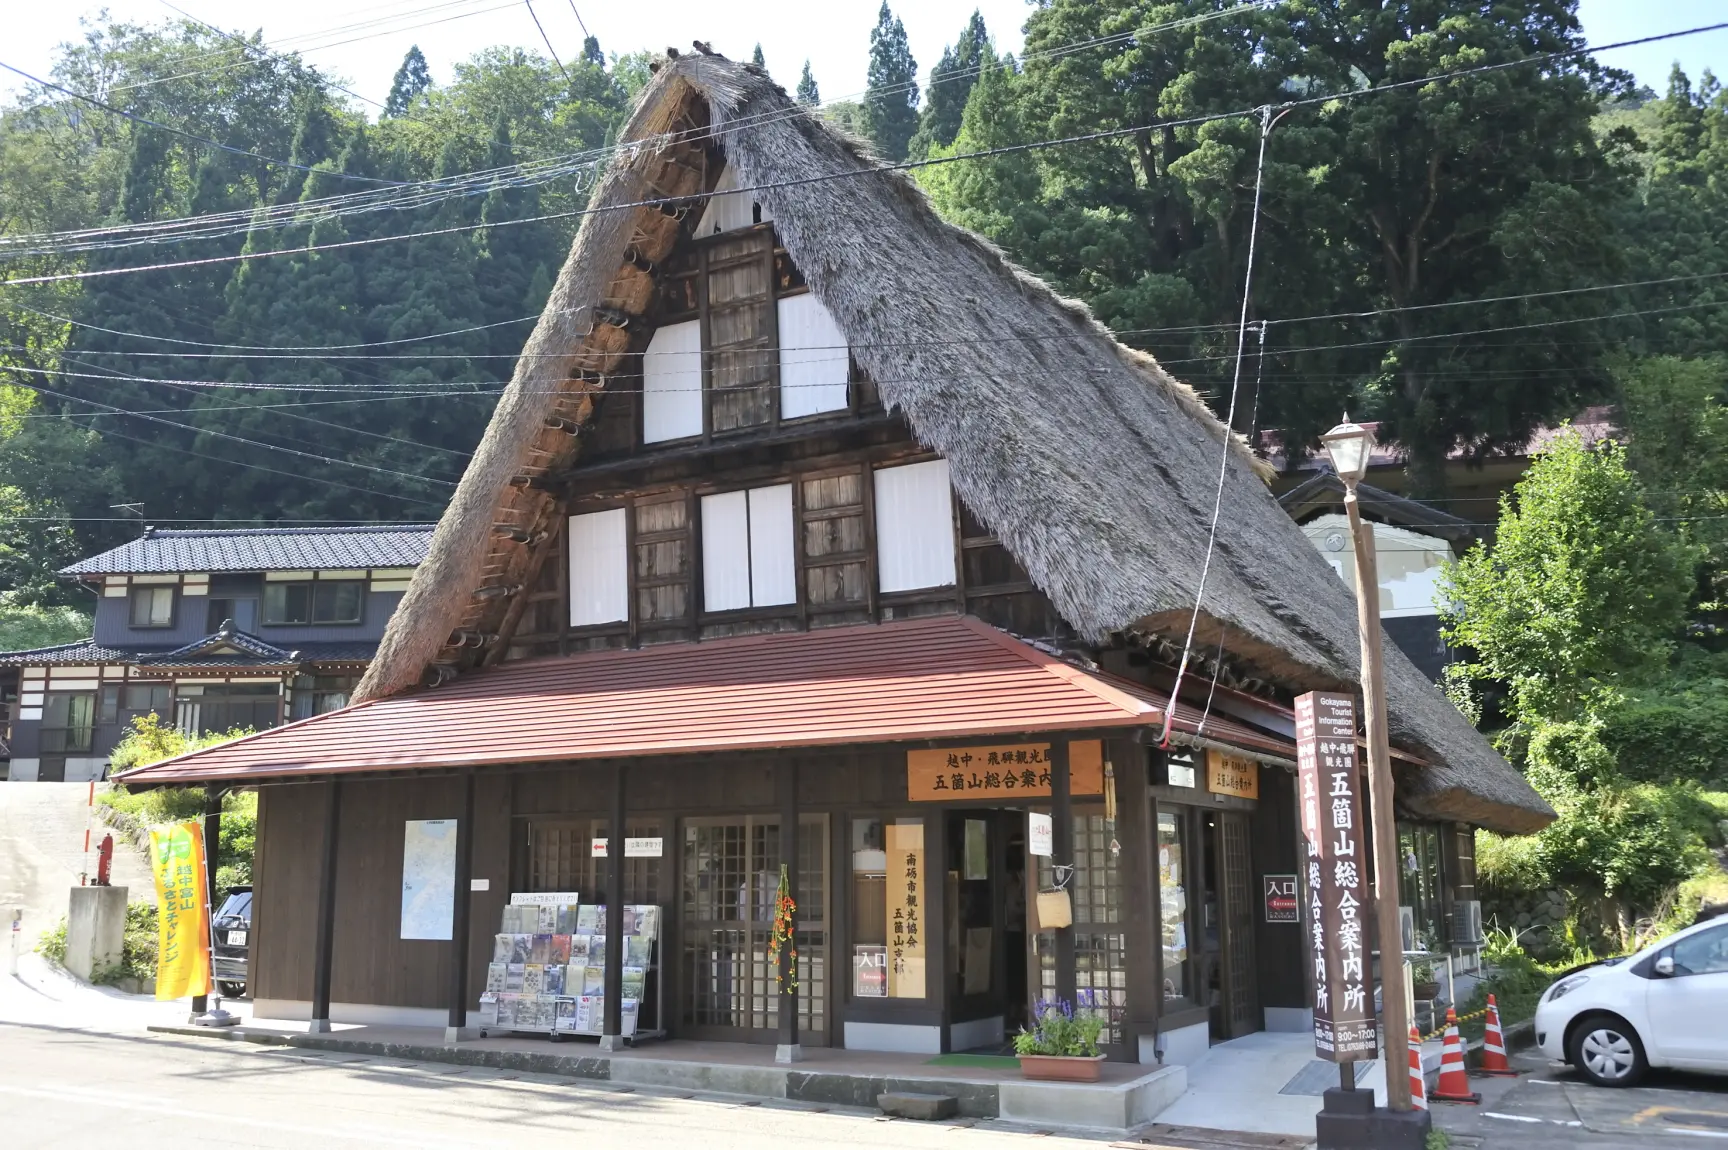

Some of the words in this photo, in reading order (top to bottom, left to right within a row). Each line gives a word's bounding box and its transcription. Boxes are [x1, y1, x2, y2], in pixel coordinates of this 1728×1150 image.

[1320, 697, 1351, 707] Gokayama
[1331, 708, 1352, 716] Tourist
[1318, 716, 1353, 726] Information
[1332, 726, 1353, 735] Center
[933, 768, 1072, 790] 五箇山総合案内
[1267, 881, 1295, 896] 入口
[1329, 772, 1366, 1013] 五箇山総合案内所
[905, 853, 918, 949] 南砺市観光協会
[859, 952, 886, 968] 入口
